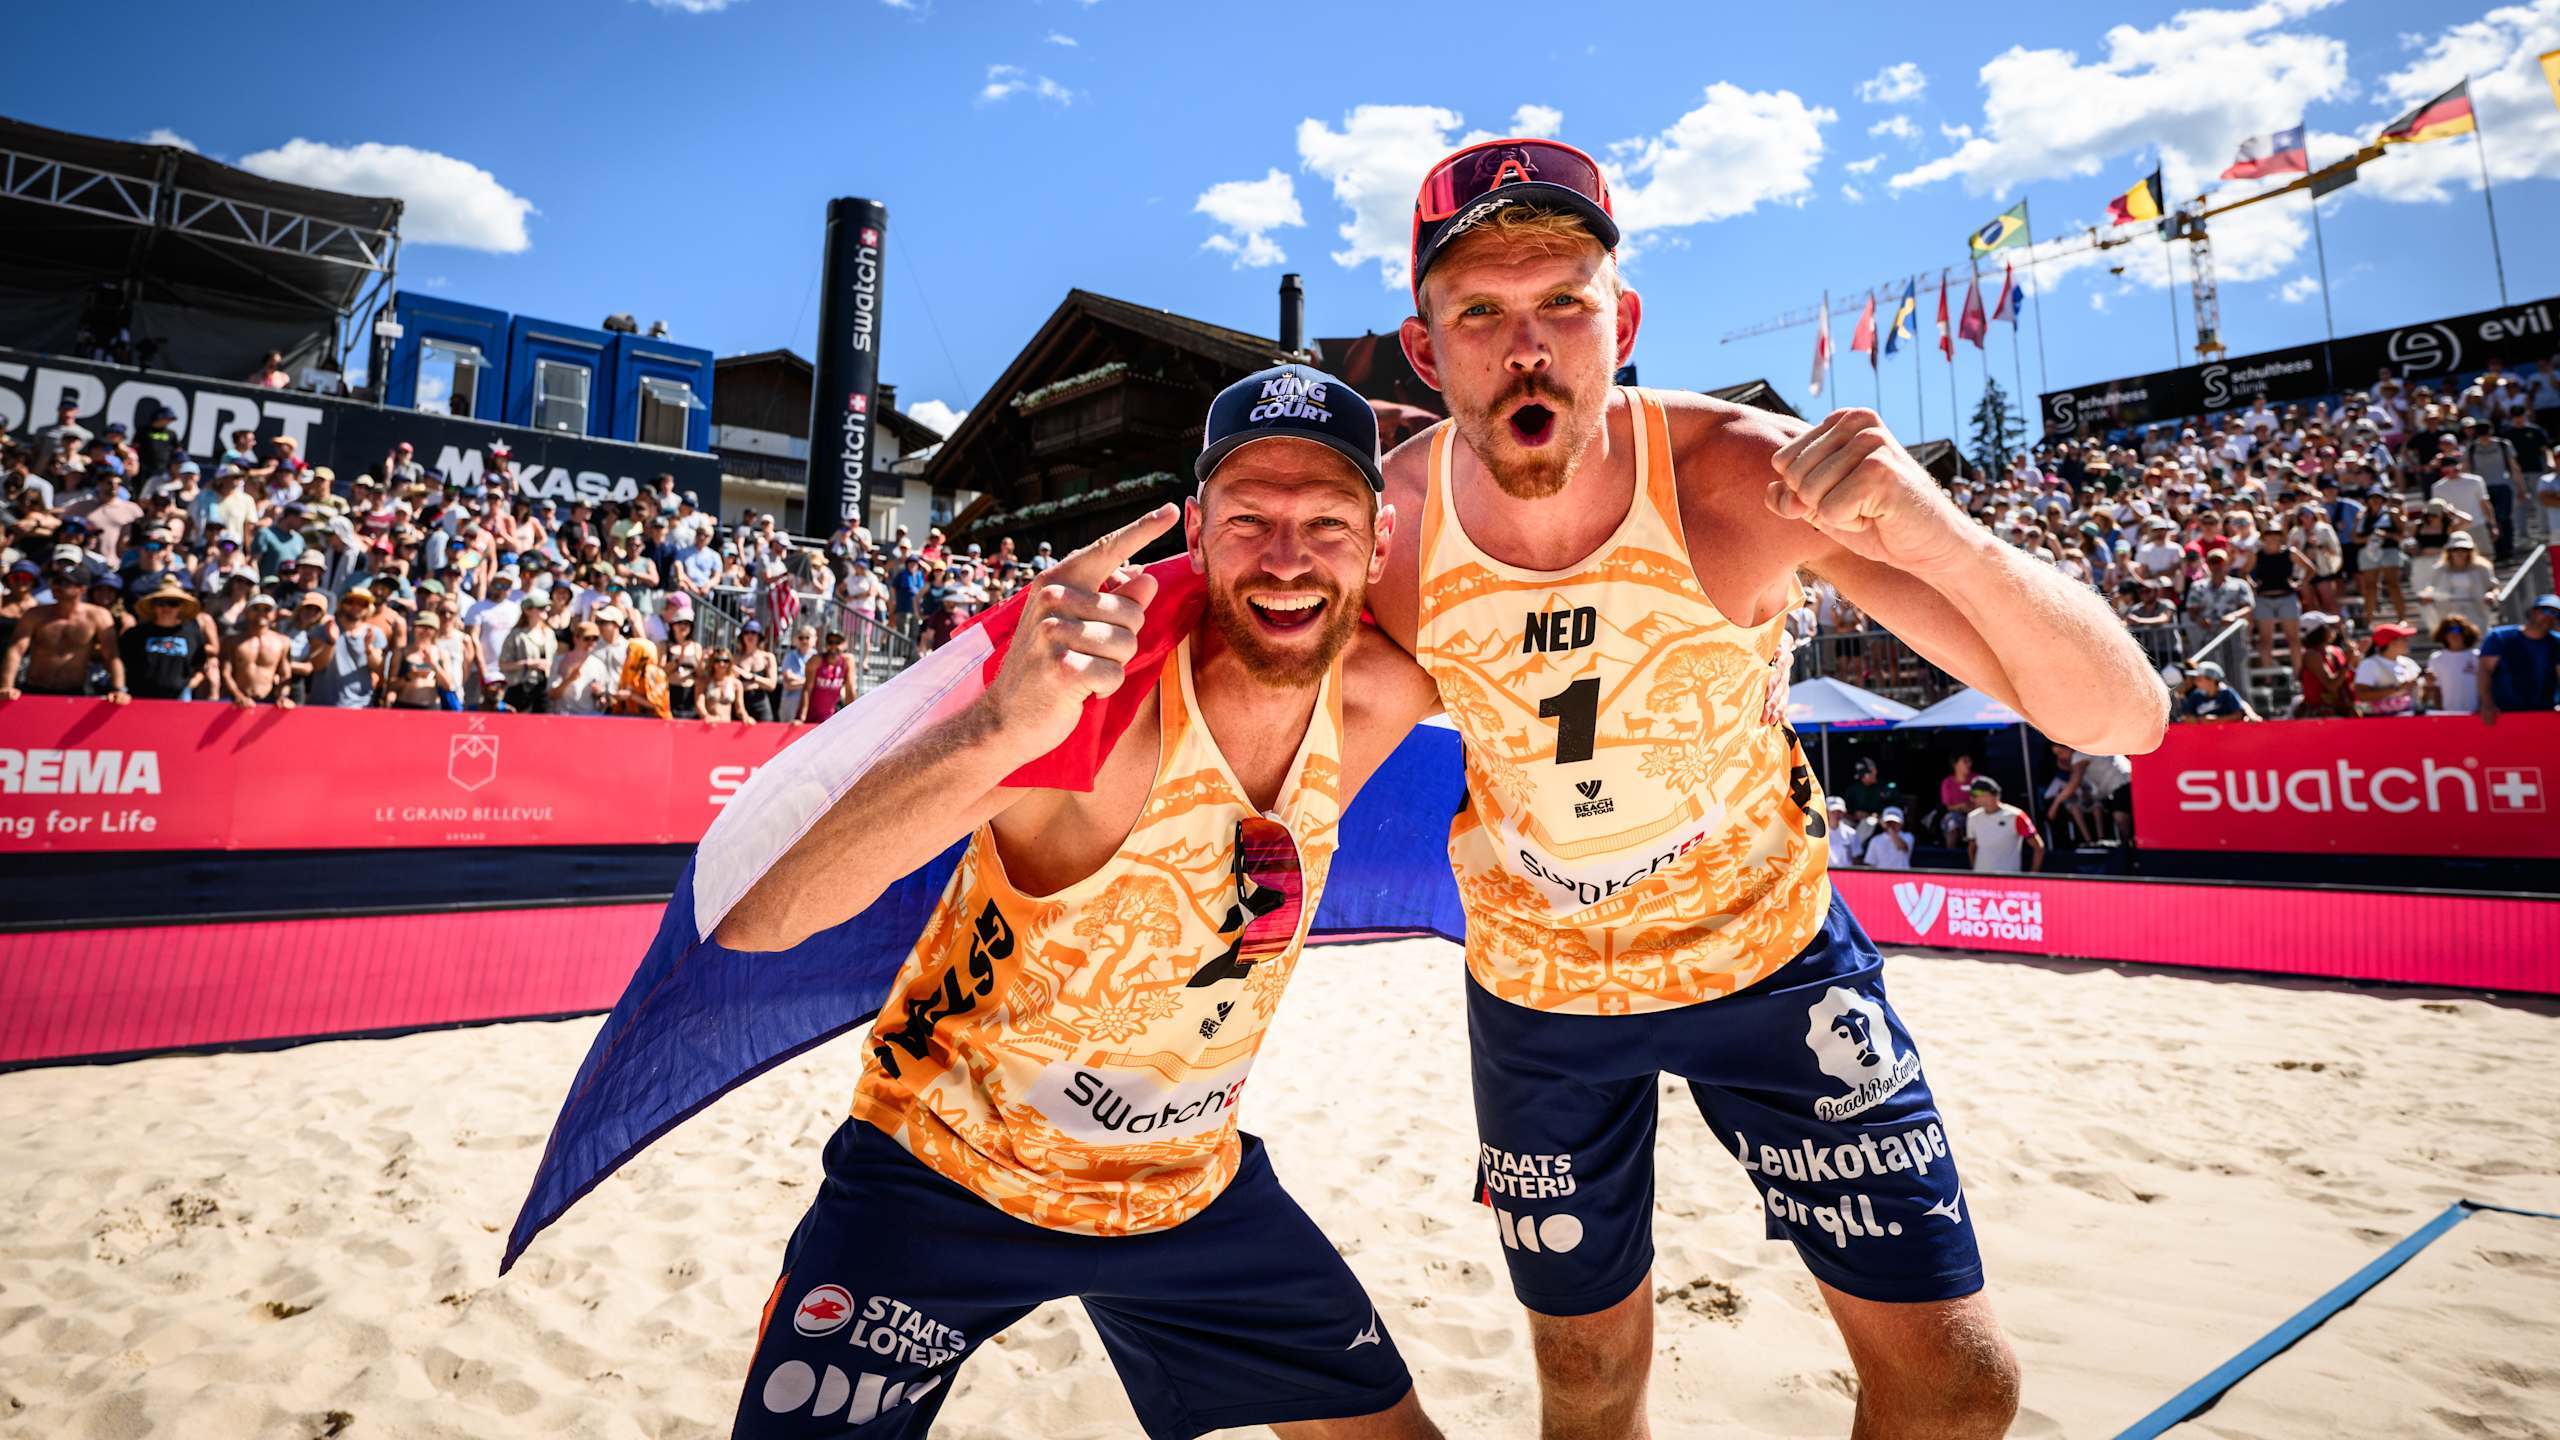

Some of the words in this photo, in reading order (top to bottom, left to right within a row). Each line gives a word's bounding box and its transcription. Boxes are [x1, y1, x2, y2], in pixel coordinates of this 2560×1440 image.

[852, 246, 877, 353] swatch
[2478, 305, 2553, 342] evil
[1260, 377, 1328, 402] KING
[1249, 402, 1333, 423] COURT
[435, 445, 639, 508] MKASA
[1522, 606, 1597, 654] NED
[1538, 677, 1600, 765] 1
[1574, 799, 1613, 814] BEACH
[2176, 758, 2479, 813] swatch
[46, 809, 93, 833] for
[101, 809, 157, 833] Life
[375, 807, 396, 821] LE
[402, 807, 467, 821] GRAND
[472, 807, 553, 821] BELLEVUE
[1947, 896, 2043, 925] BEACH
[1063, 1071, 1226, 1133] swatch
[1482, 1142, 1572, 1177] STAATS
[1735, 1122, 1946, 1183] Leukotape
[862, 1295, 967, 1352] STAATS
